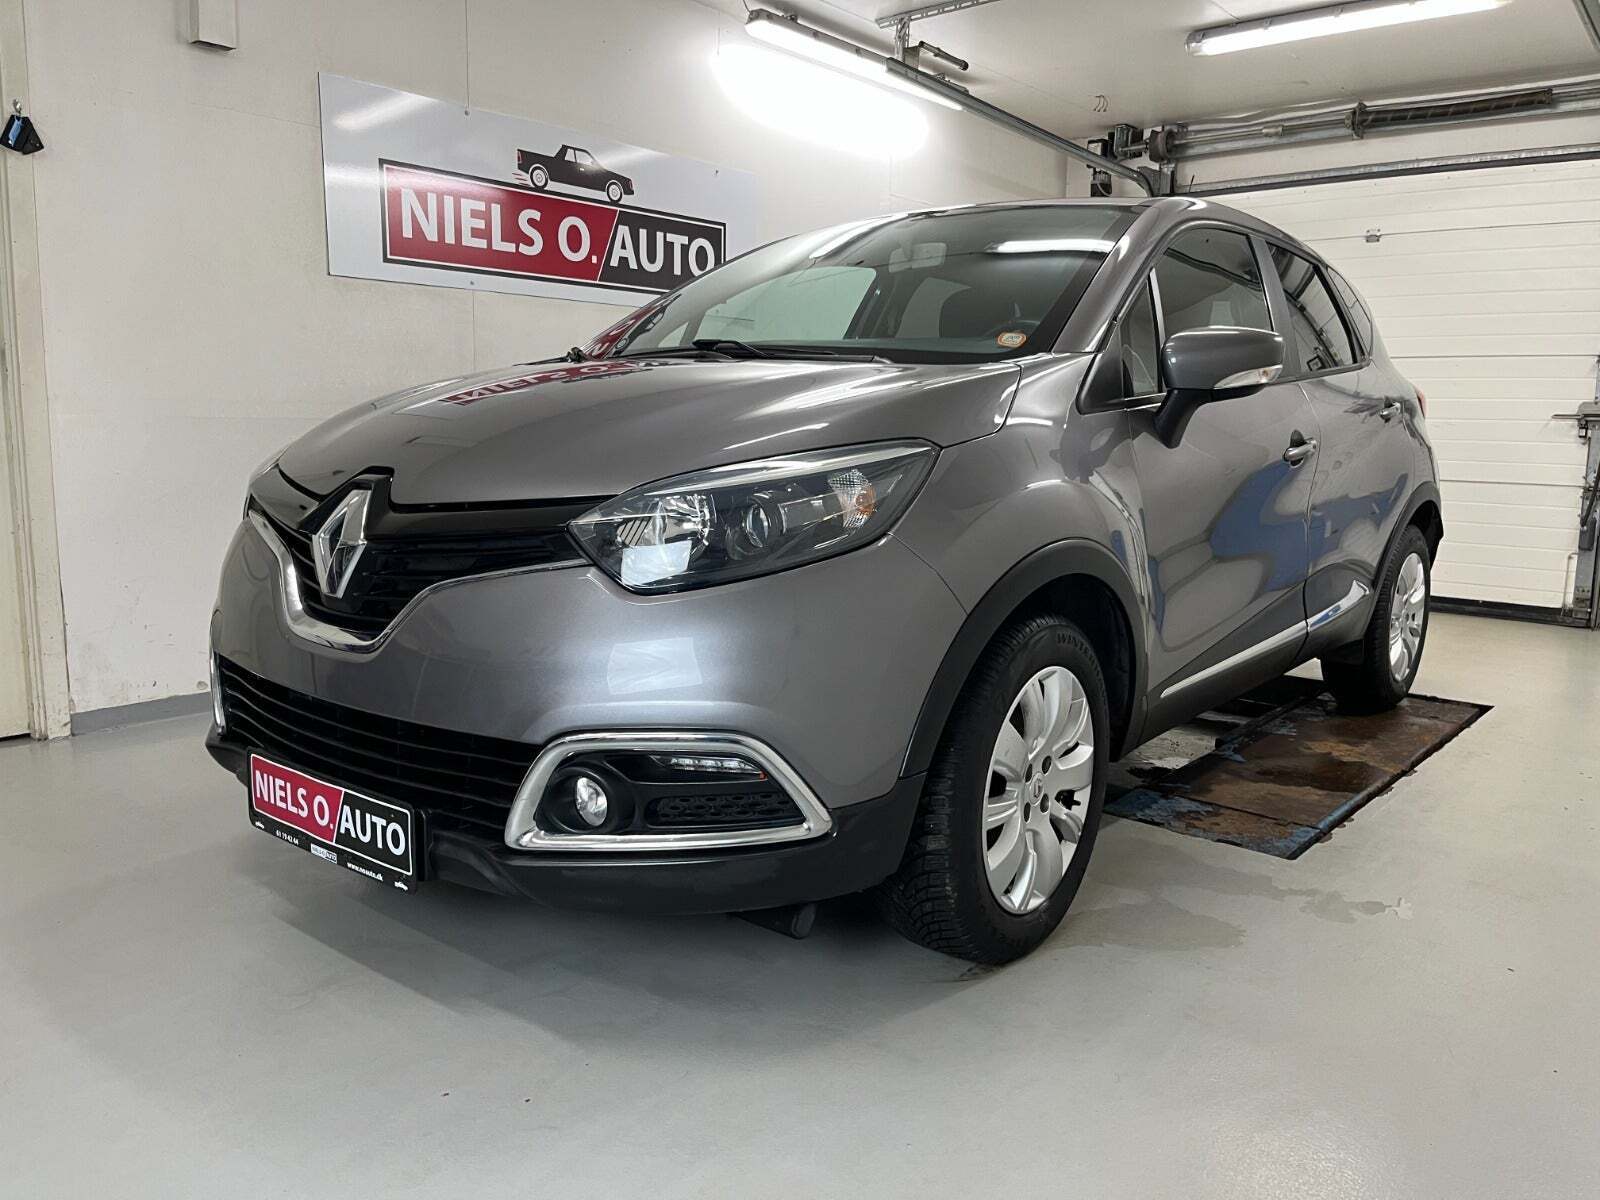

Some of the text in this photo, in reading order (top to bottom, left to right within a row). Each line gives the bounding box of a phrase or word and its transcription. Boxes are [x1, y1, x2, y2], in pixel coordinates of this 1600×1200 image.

[401, 189, 715, 278] NIELS O. AUTO
[255, 770, 406, 856] NIELS O. AUTO
